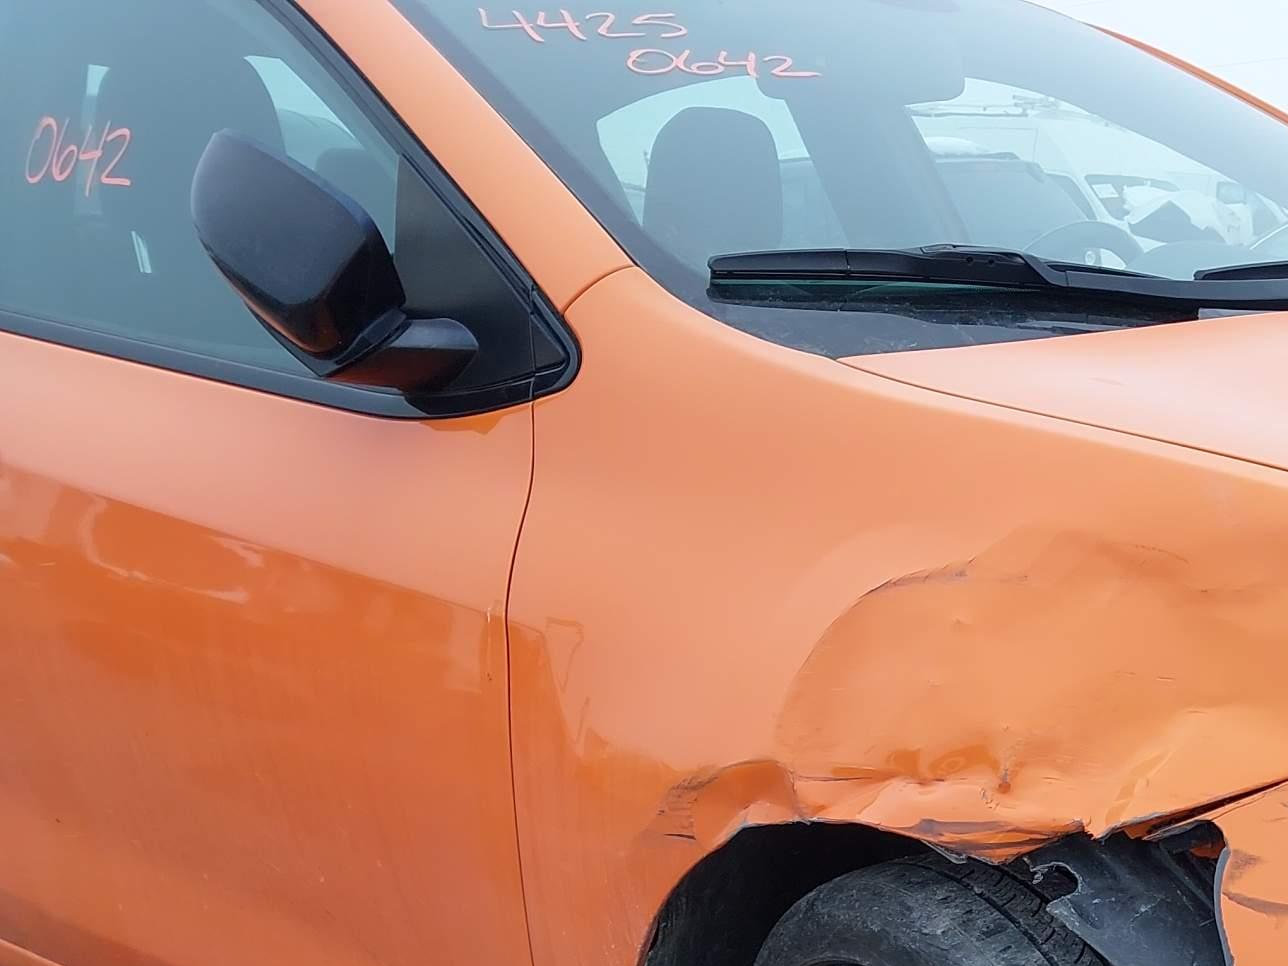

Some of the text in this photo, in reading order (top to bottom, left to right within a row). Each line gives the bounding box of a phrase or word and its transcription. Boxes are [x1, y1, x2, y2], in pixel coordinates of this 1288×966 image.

[478, 8, 688, 42] 4425
[627, 48, 823, 77] 0642
[25, 116, 131, 197] 0642
